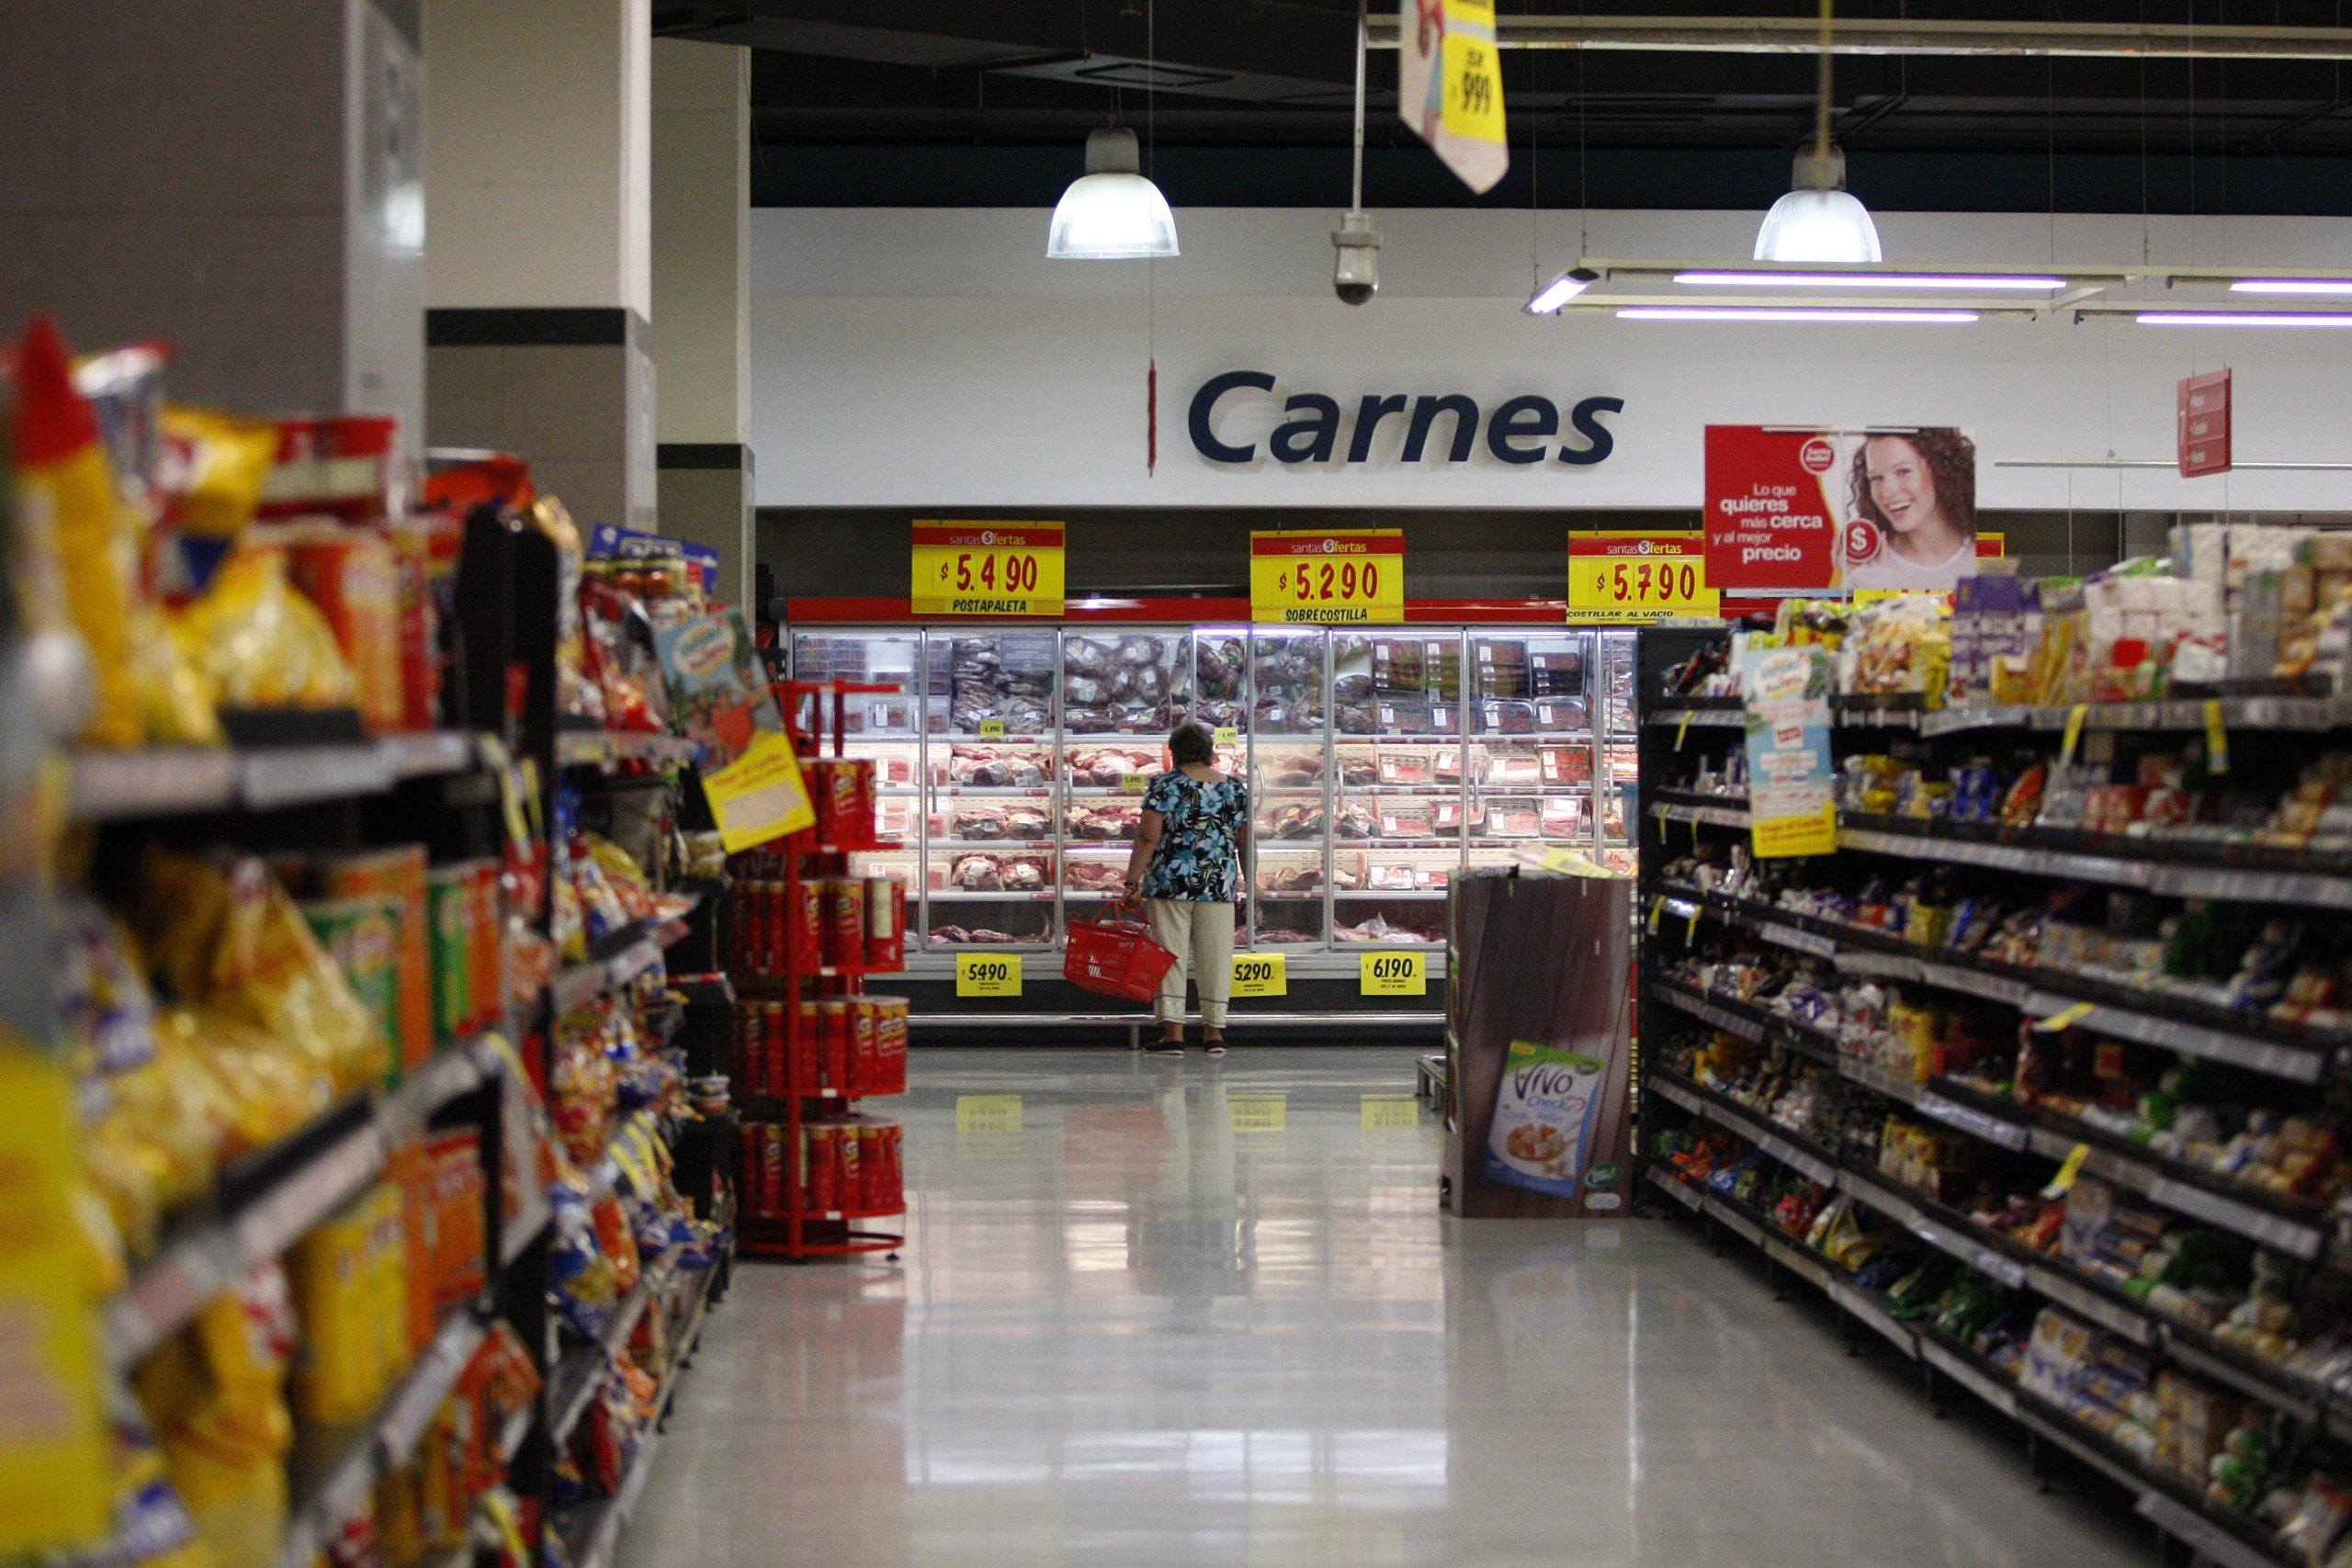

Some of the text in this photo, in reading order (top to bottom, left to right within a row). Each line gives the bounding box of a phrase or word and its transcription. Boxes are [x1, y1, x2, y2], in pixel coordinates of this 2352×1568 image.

[1188, 370, 1624, 465] Carnes
[1752, 483, 1797, 498] Lo que
[1720, 495, 1789, 516] quieres
[1770, 514, 1823, 529] cerca
[1713, 531, 1772, 547] y al mejor
[1742, 544, 1802, 564] precio
[956, 554, 1037, 592] 5.490
[1296, 561, 1377, 600] 5.290
[1614, 563, 1695, 601] 5.790
[953, 600, 1027, 613] POSTAPALETA
[1286, 608, 1367, 622] SOBRECOSTILLA
[1566, 610, 1674, 618] COSTILLAR AL VACIO
